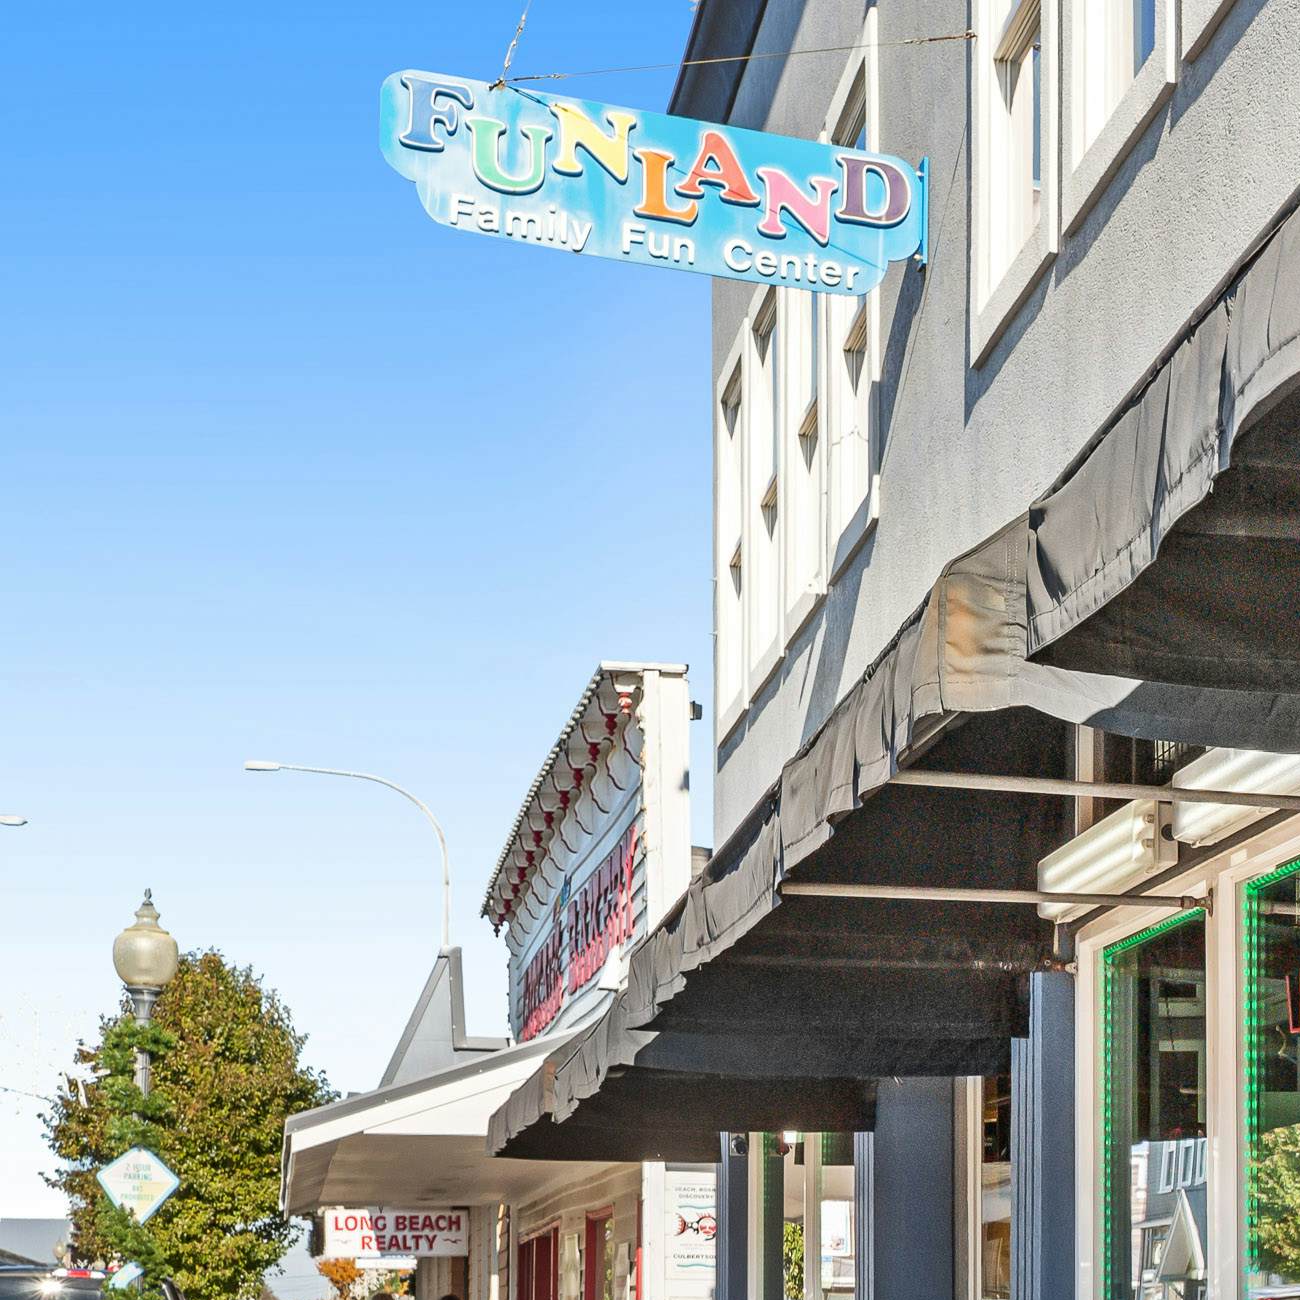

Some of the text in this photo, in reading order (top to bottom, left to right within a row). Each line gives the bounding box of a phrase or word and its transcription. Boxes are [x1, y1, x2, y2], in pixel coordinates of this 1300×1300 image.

[399, 74, 911, 245] FUNLAND
[448, 192, 861, 290] Family Fun Center
[334, 1215, 461, 1232] LONG BEACH
[361, 1234, 438, 1250] REALTY
